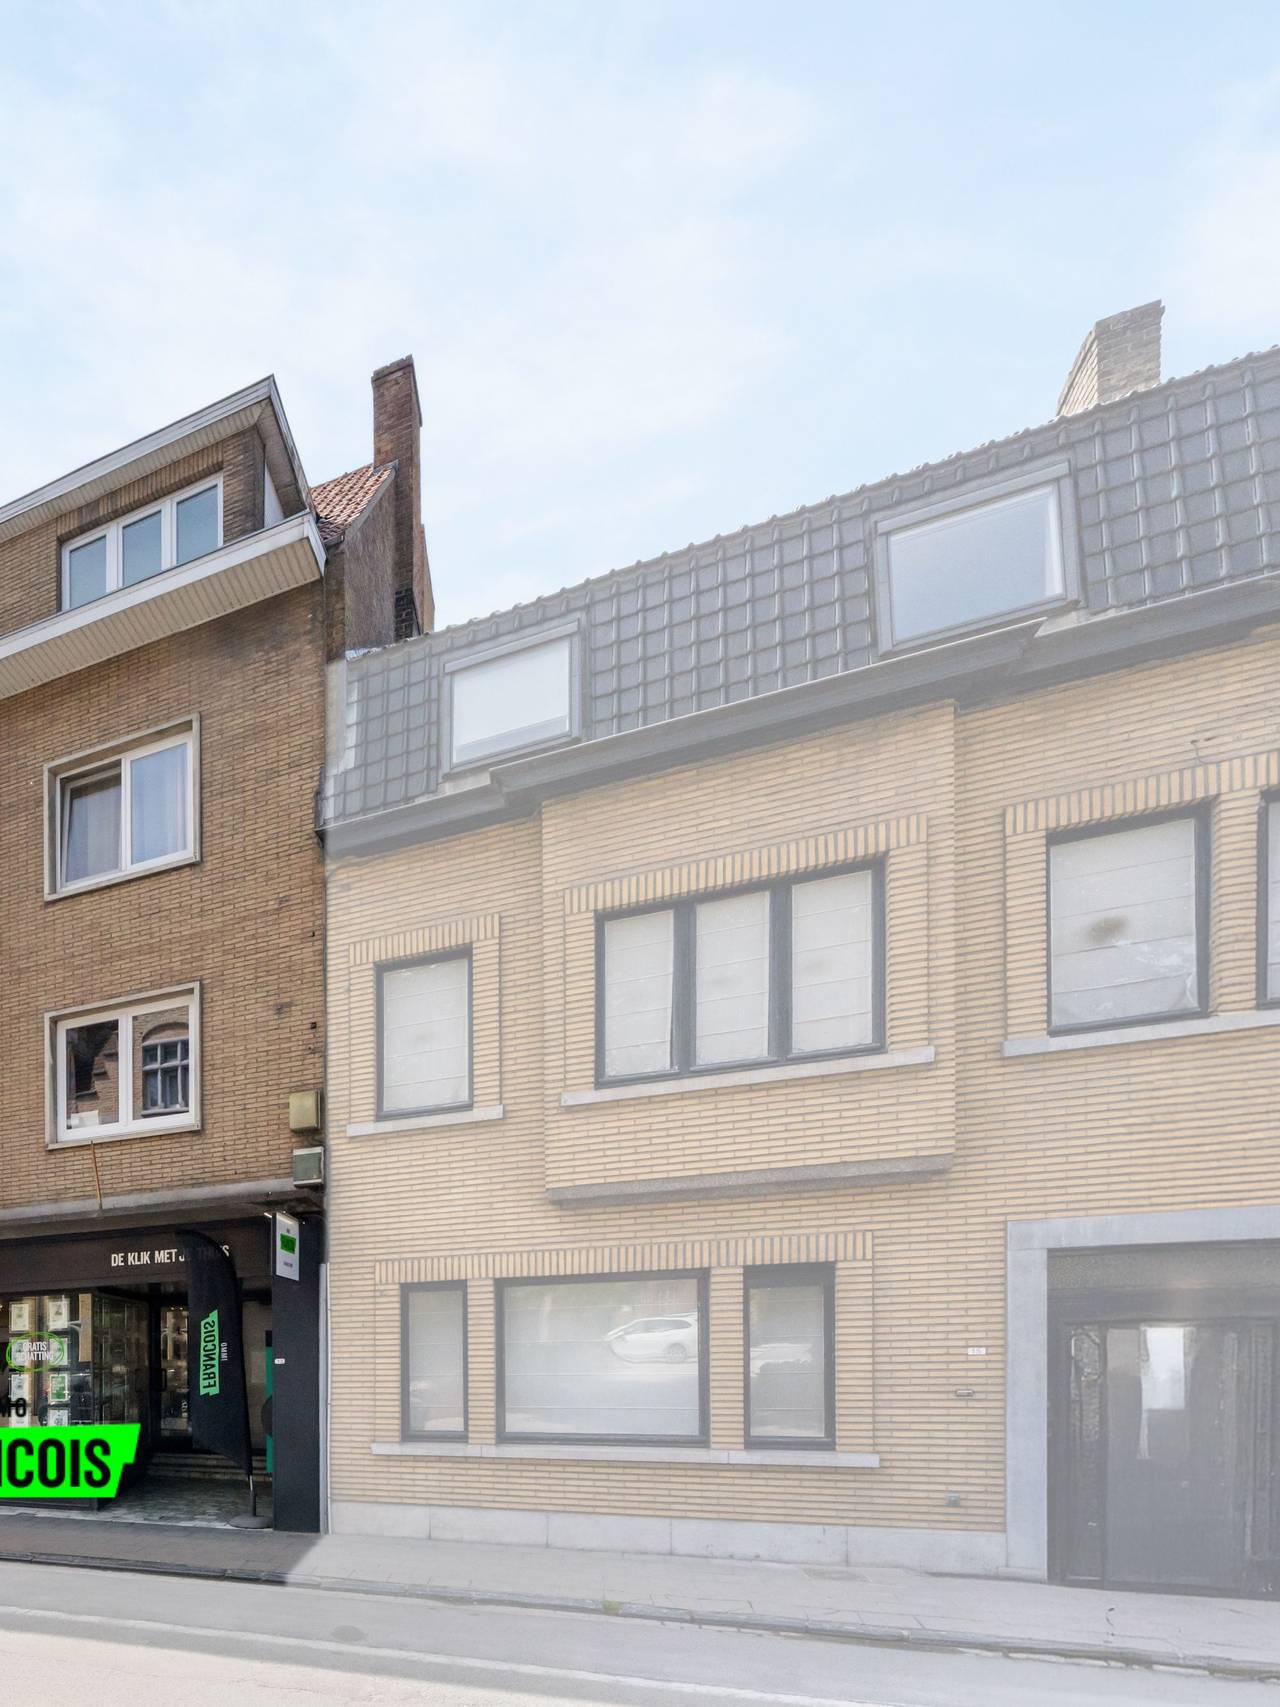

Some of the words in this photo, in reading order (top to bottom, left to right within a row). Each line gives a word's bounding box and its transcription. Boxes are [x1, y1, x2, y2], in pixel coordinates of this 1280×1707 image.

[111, 1253, 124, 1267] DE
[128, 1251, 151, 1266] KLIK
[154, 1249, 178, 1264] MET
[23, 1341, 47, 1351] GRATIS
